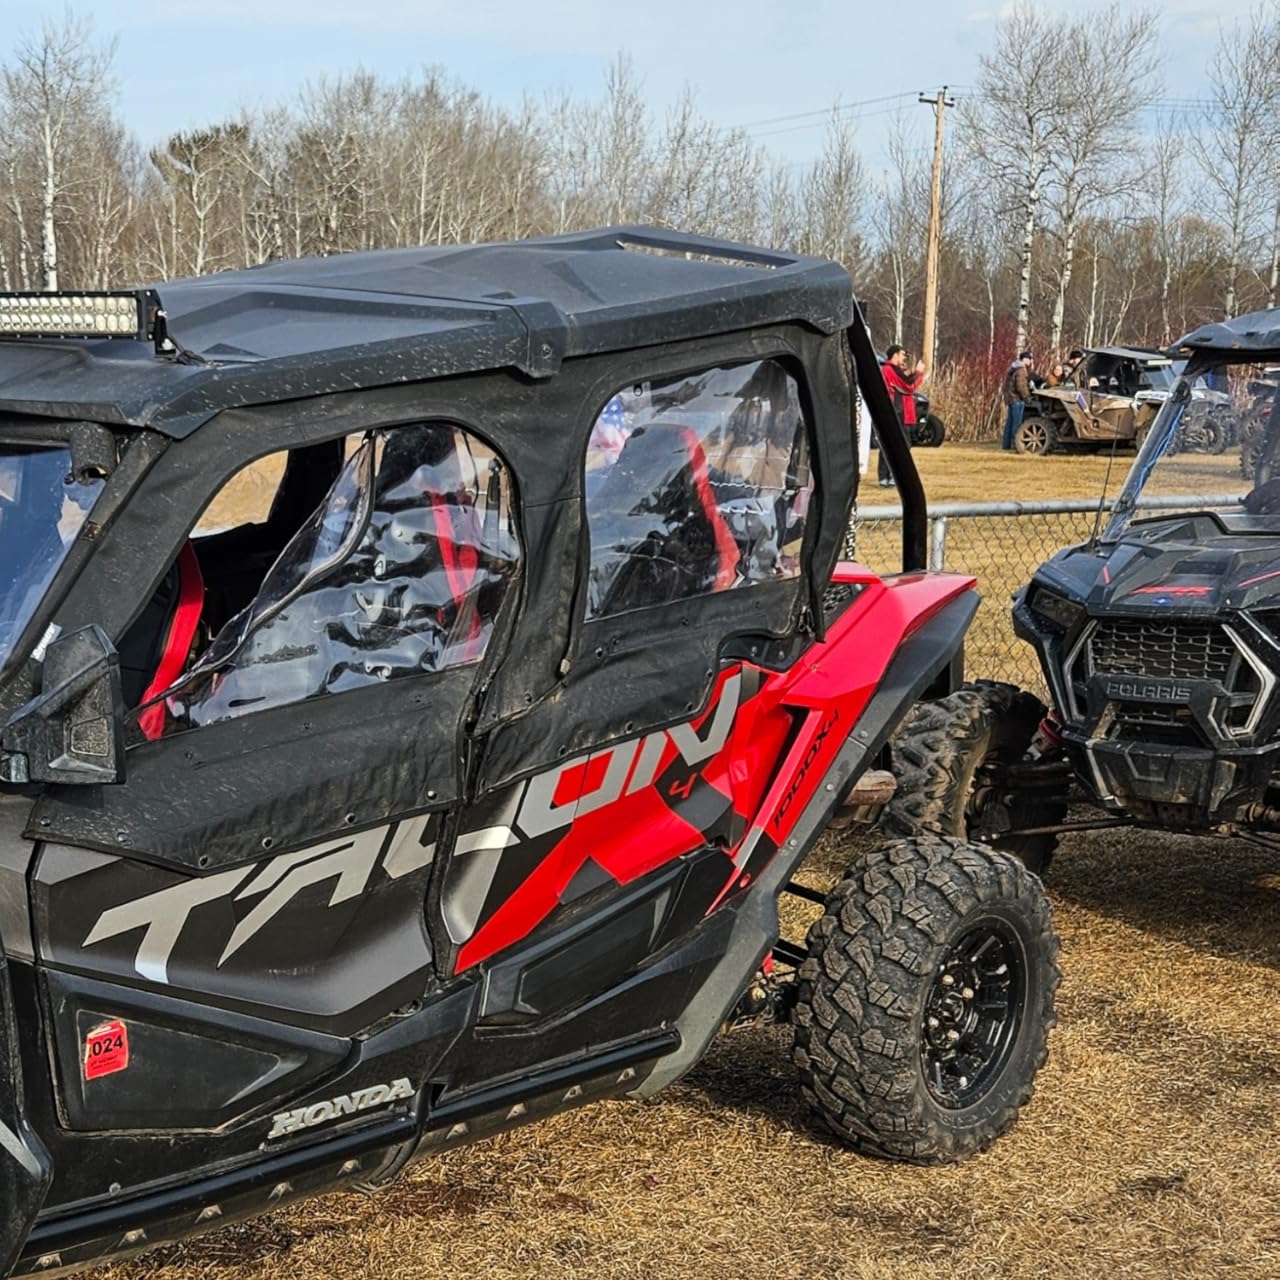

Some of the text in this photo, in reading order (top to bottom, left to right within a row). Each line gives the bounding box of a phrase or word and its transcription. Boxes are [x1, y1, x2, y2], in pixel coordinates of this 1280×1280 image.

[1106, 682, 1193, 700] POLARIS
[670, 773, 698, 798] 4
[89, 1035, 124, 1058] 024
[267, 1077, 416, 1139] HONDA
